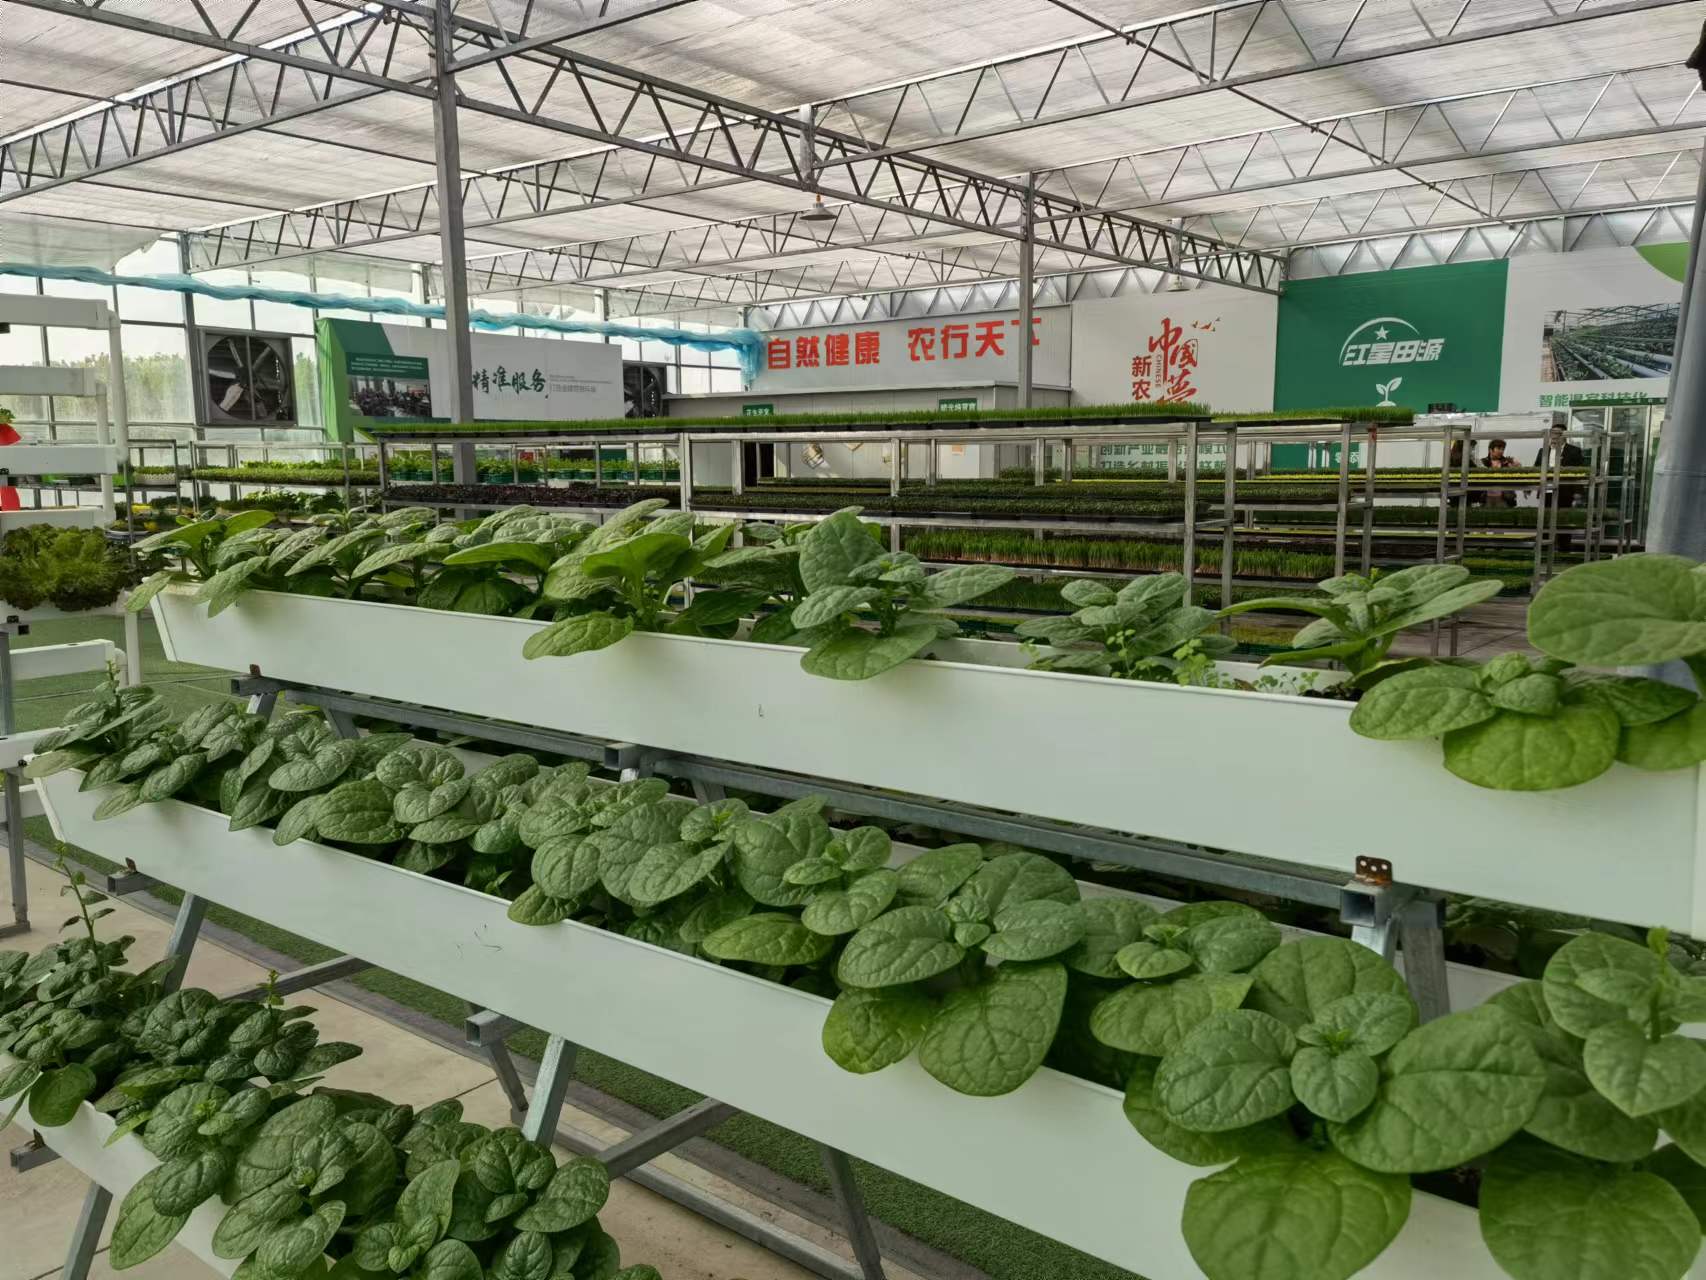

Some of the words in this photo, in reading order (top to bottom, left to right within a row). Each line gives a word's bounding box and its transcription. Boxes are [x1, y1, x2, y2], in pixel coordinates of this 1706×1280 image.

[767, 331, 880, 370] 自然健康
[1342, 338, 1445, 366] 红星田源
[472, 365, 546, 395] 精准服务
[1132, 355, 1152, 400] 新农
